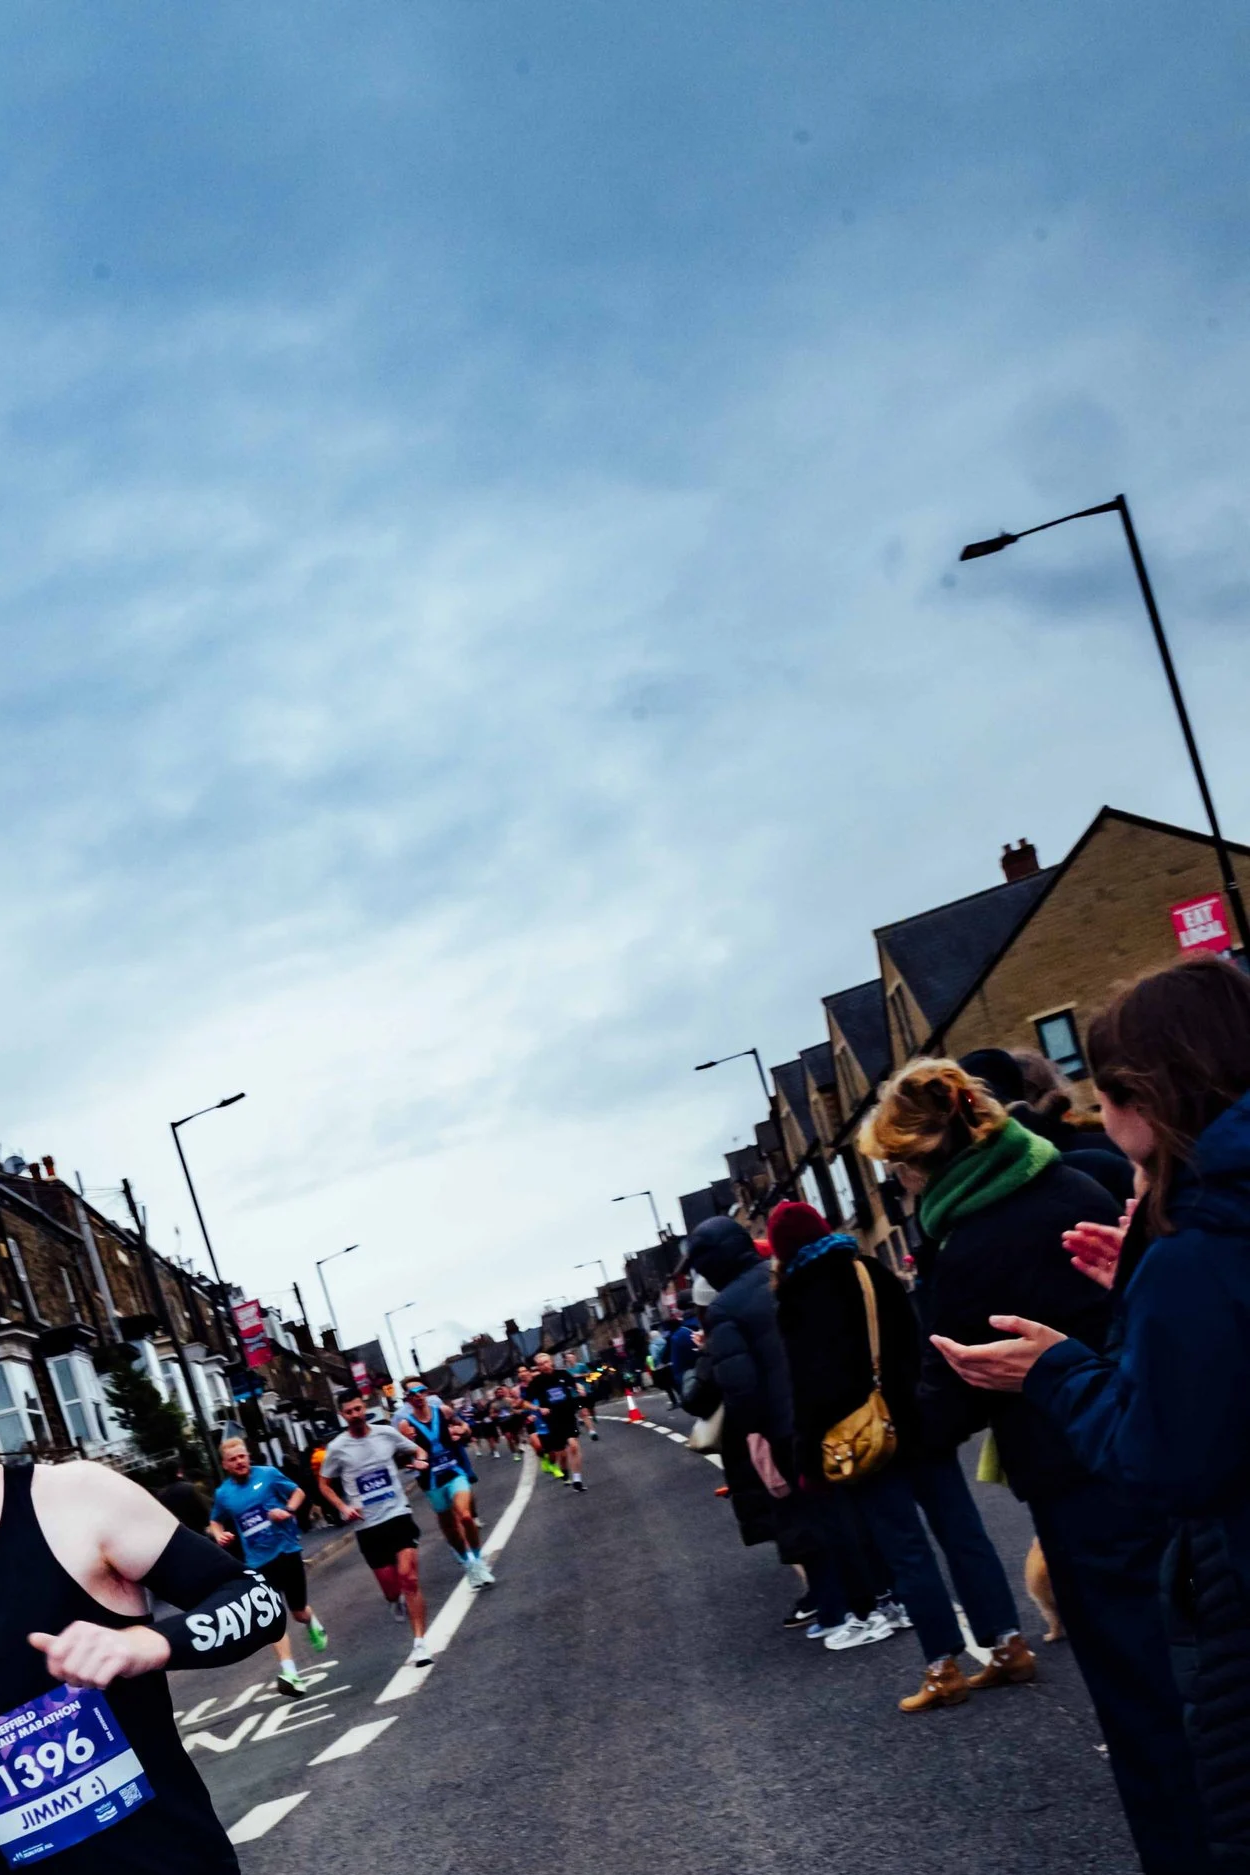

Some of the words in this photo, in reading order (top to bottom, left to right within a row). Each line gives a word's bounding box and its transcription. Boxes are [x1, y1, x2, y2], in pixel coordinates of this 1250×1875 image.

[1179, 920, 1227, 948] LOCAL
[1182, 905, 1213, 930] EAT
[19, 1700, 82, 1739] MARATHON
[20, 1786, 84, 1830] JIMMY
